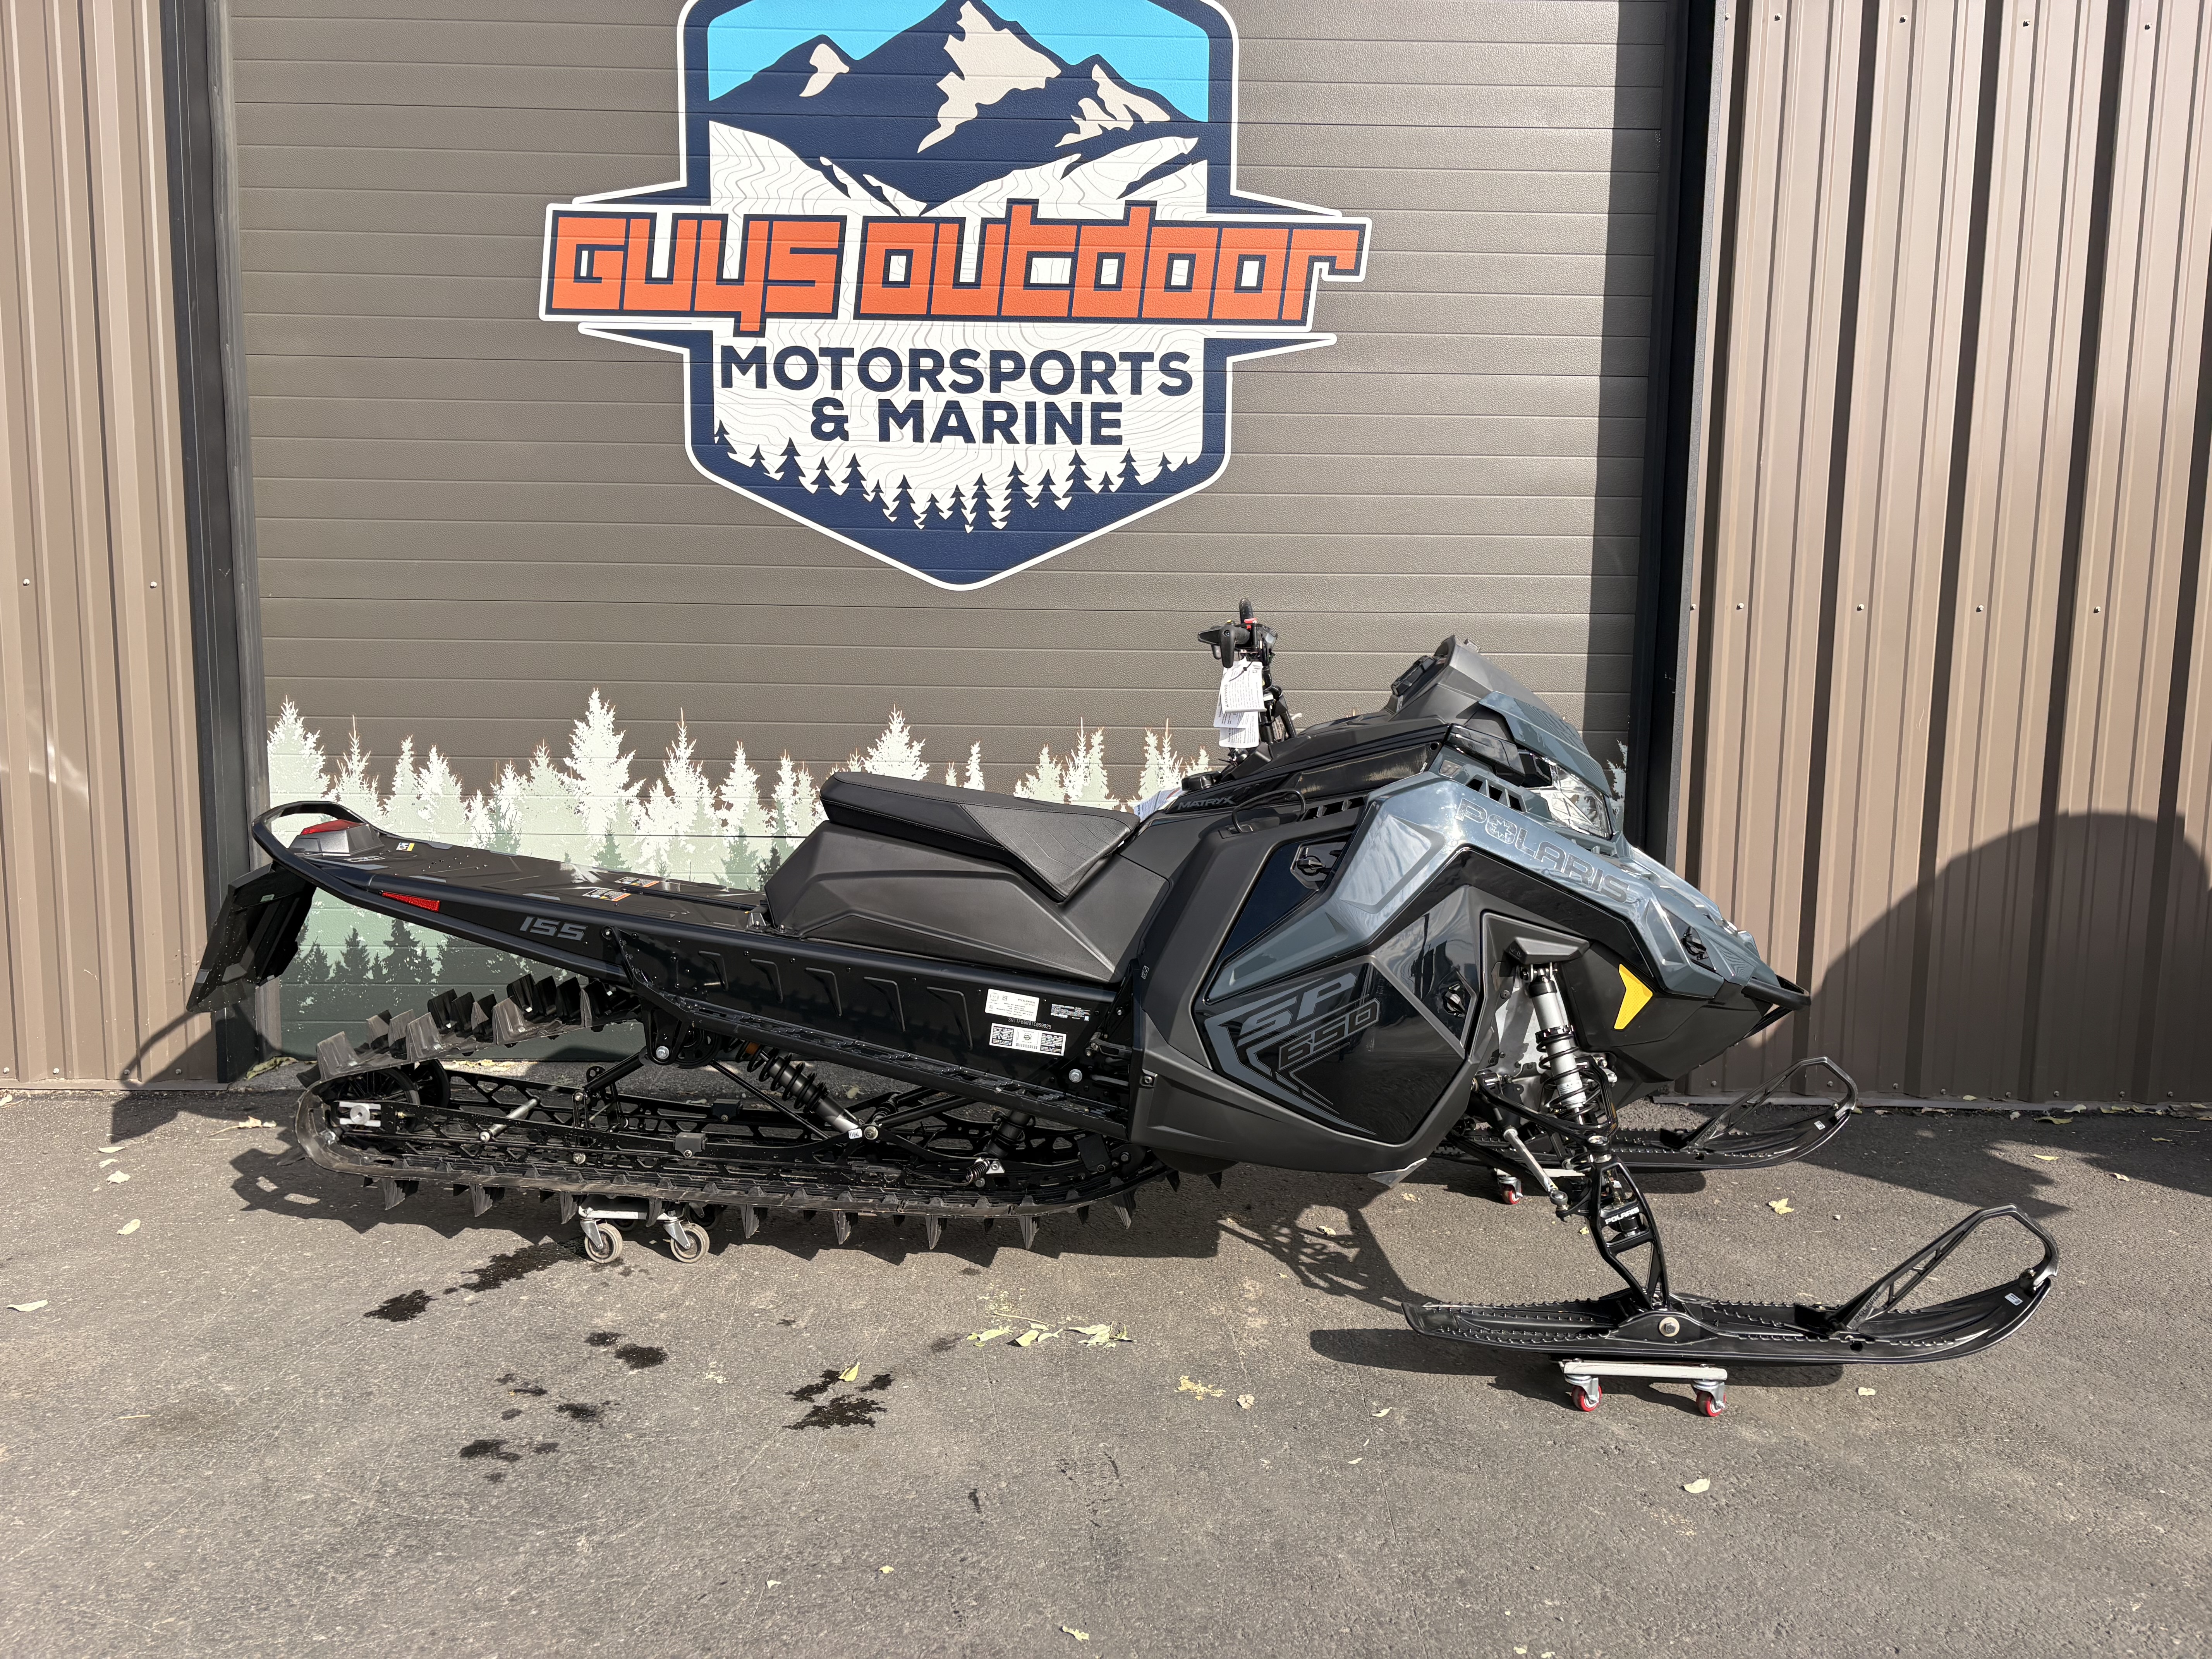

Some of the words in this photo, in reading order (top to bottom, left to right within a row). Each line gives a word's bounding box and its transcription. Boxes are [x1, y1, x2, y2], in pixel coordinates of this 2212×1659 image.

[720, 345, 1193, 397] MOTORSPORTS
[810, 396, 849, 441] &
[878, 398, 1123, 446] MARINE
[1177, 795, 1236, 810] MATRYX
[1454, 798, 1630, 903] POLARIS
[520, 916, 588, 941] 155
[1237, 972, 1357, 1047] SP
[1278, 998, 1381, 1071] 650
[1604, 1207, 1640, 1224] POLARIS
